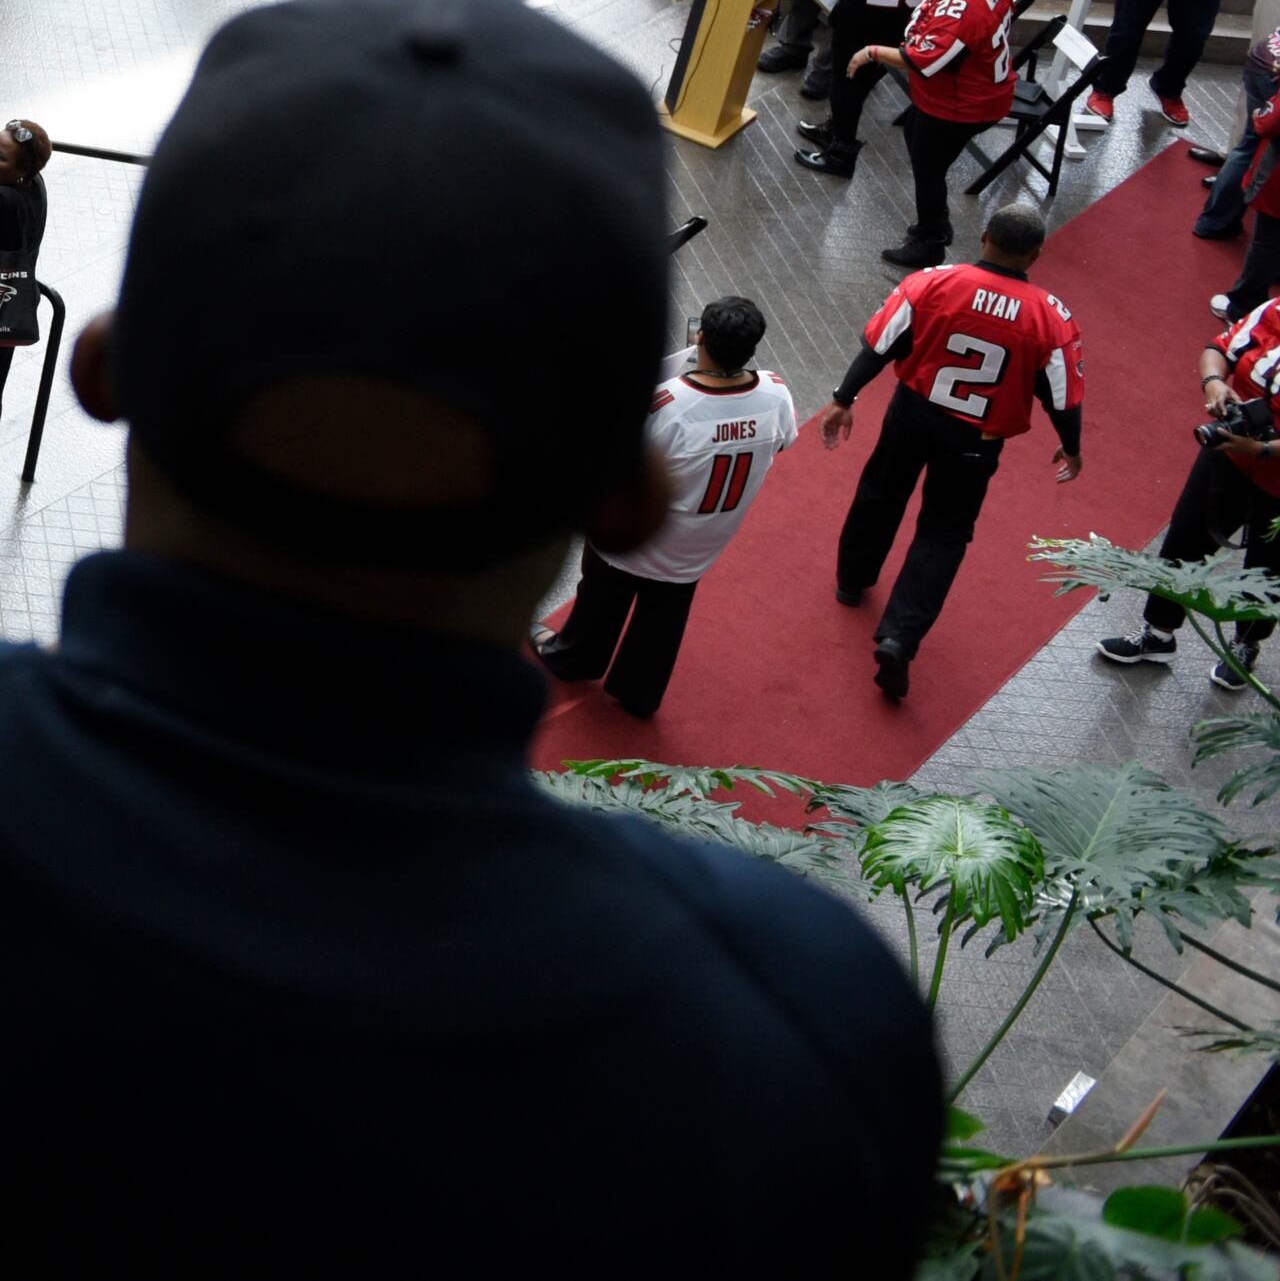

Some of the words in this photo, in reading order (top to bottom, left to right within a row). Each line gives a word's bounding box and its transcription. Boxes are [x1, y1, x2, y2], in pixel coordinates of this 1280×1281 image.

[971, 287, 1022, 322] RYAN
[1047, 293, 1072, 322] 2
[928, 333, 1009, 418] 2
[711, 420, 758, 444] JONES
[696, 451, 754, 515] 11
